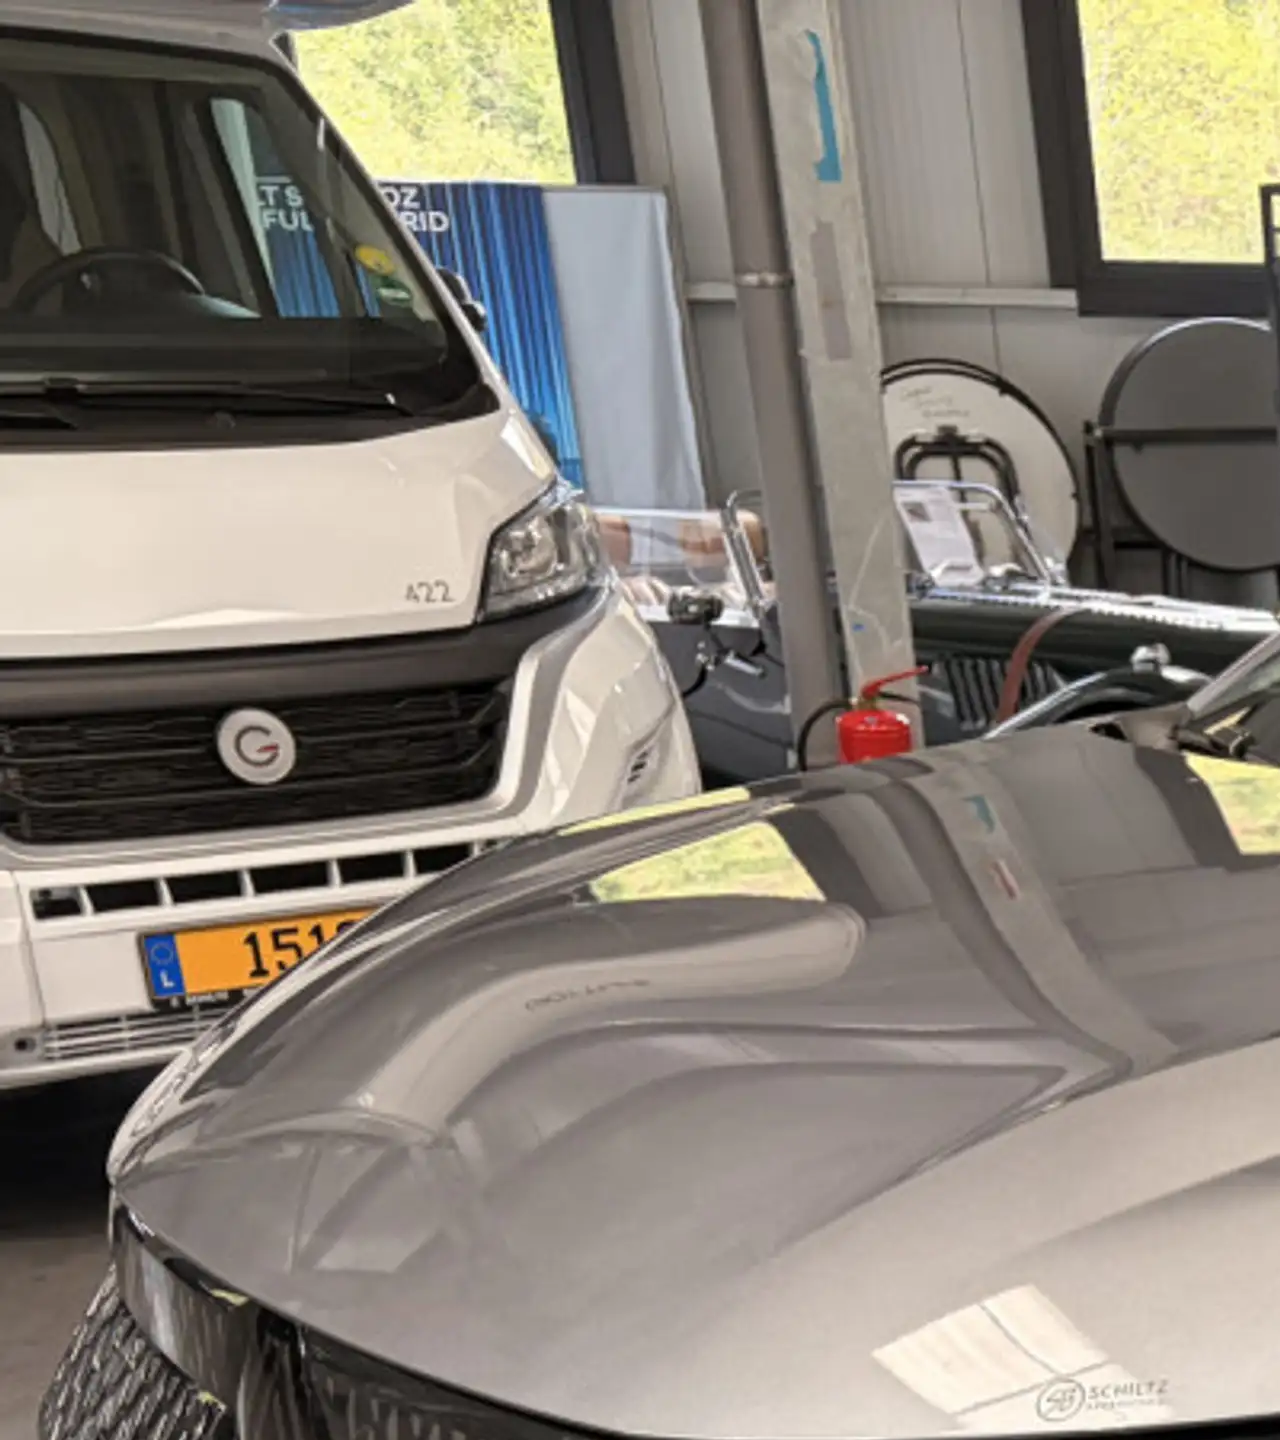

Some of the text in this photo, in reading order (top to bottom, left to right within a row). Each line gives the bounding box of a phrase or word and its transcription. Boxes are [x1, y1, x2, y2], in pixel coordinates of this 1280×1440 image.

[404, 579, 457, 603] 422
[158, 918, 360, 989] L 151
[1088, 1379, 1170, 1400] SCHILTZ
